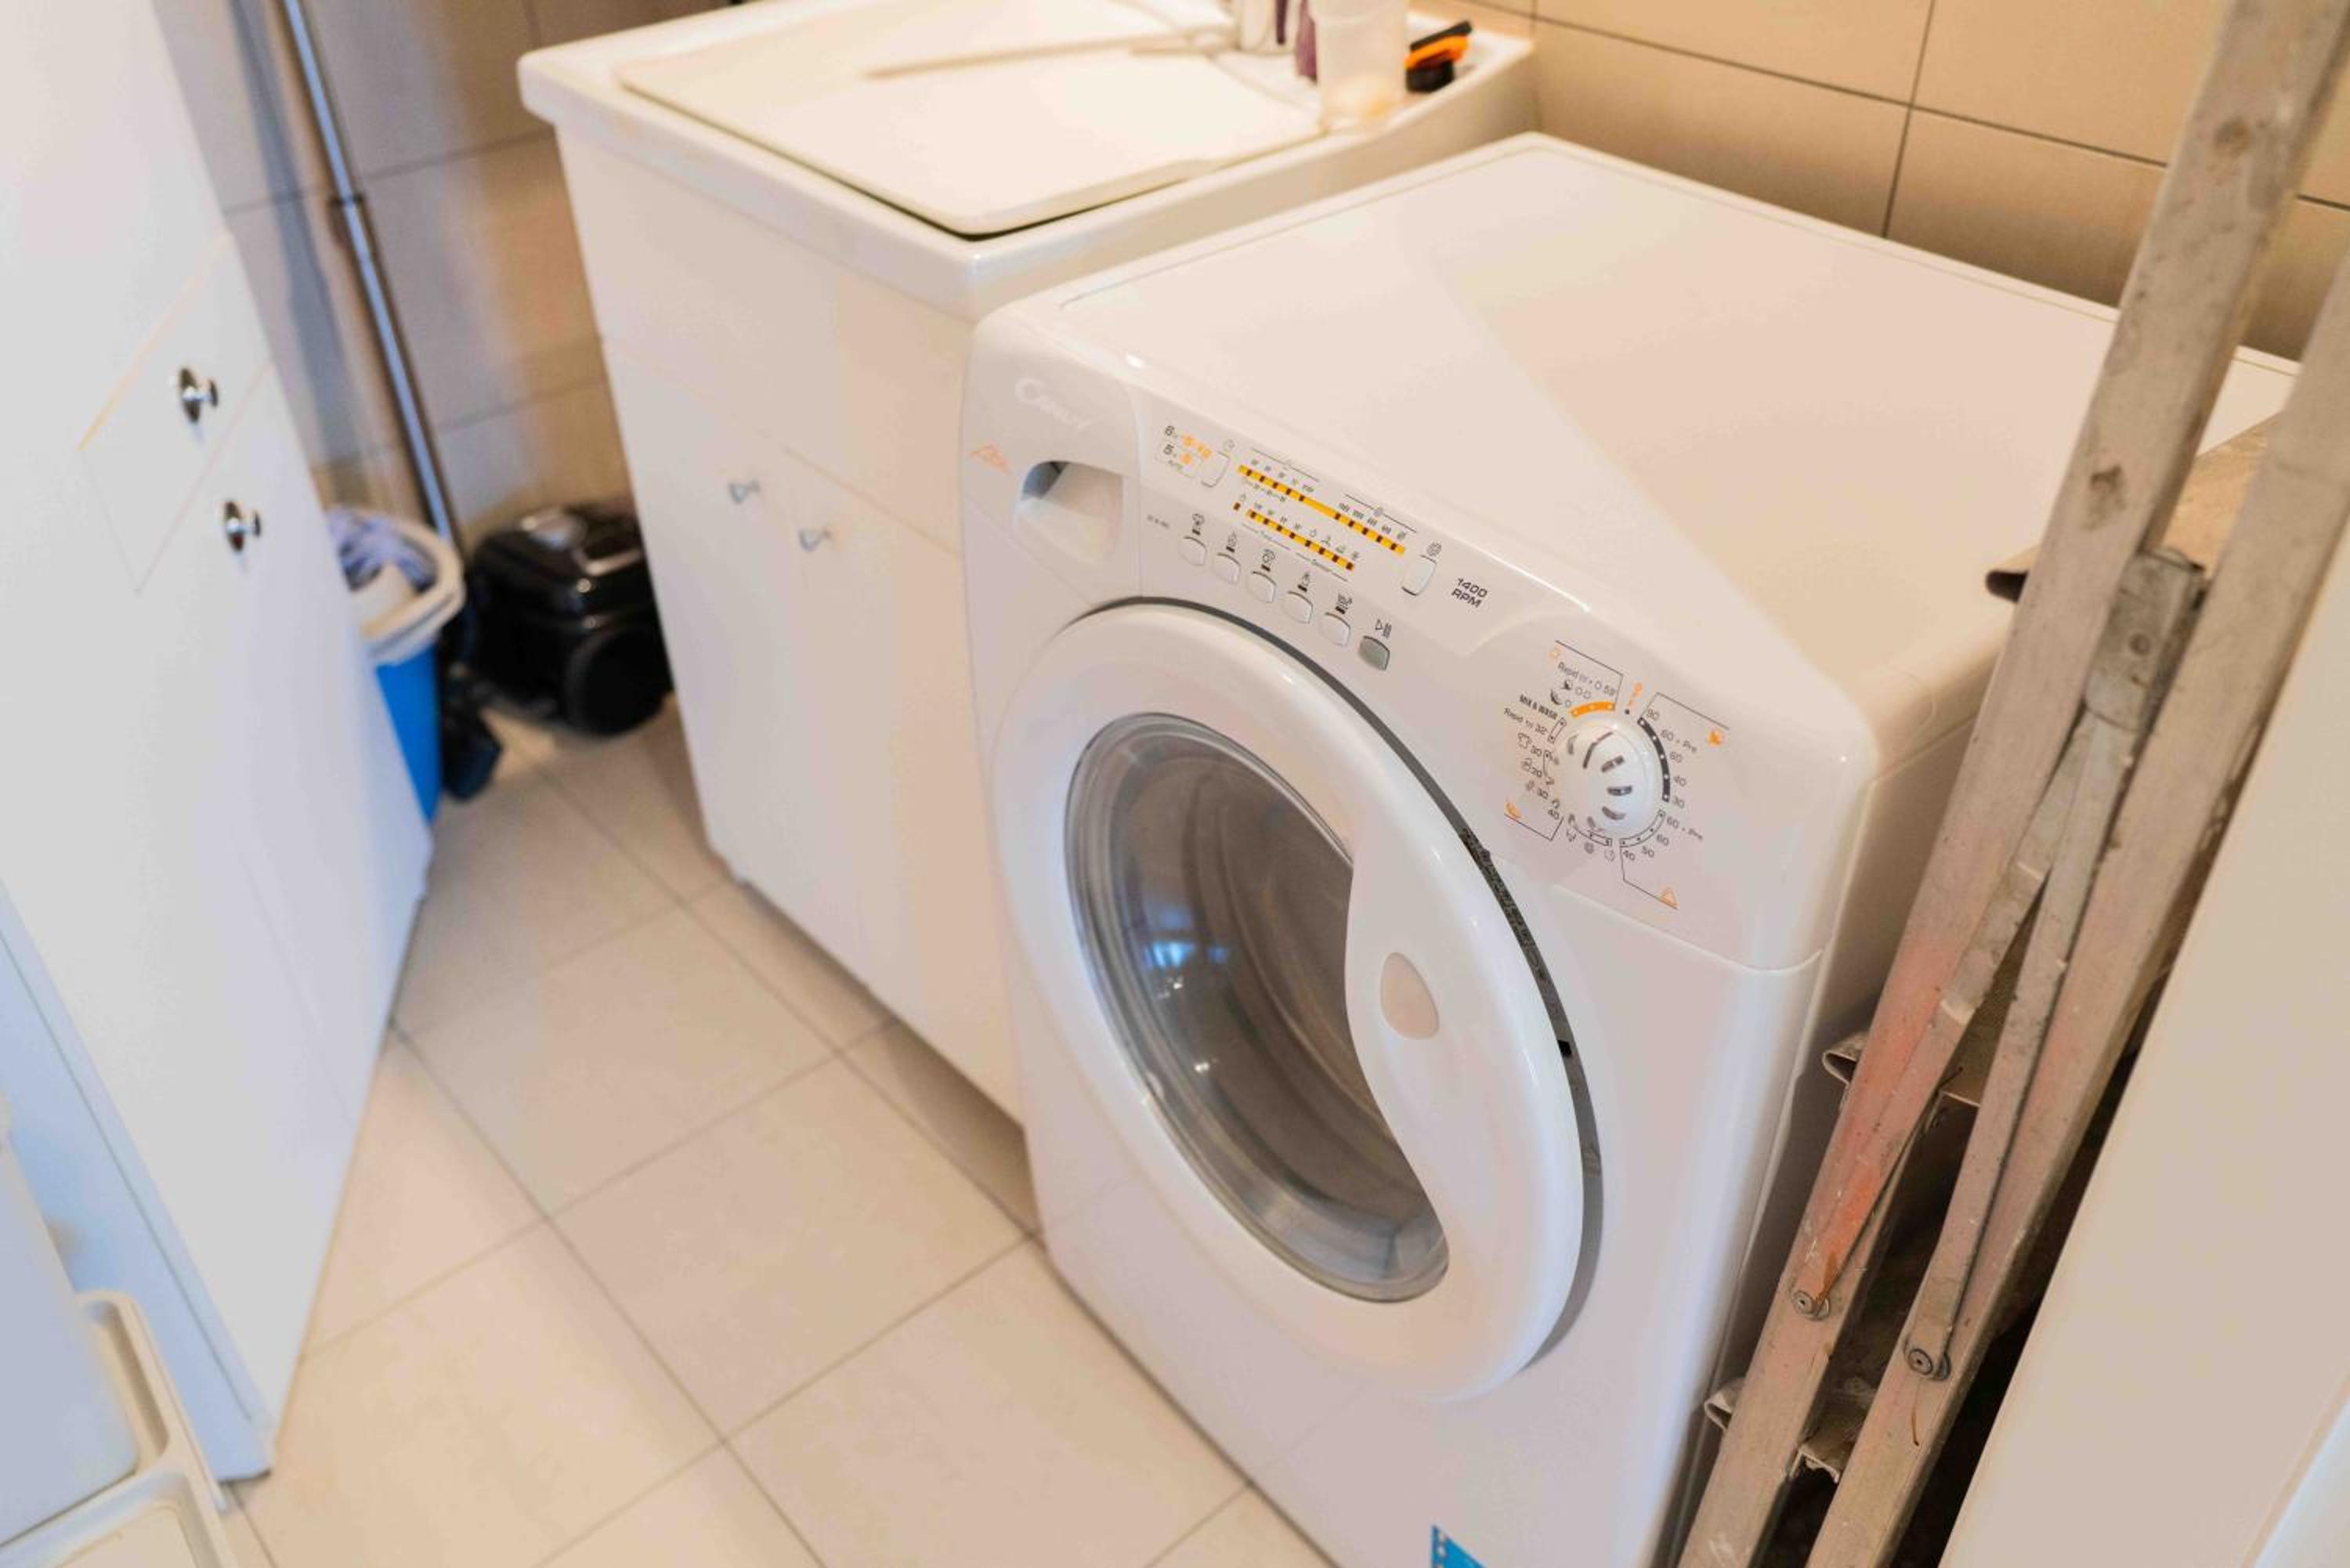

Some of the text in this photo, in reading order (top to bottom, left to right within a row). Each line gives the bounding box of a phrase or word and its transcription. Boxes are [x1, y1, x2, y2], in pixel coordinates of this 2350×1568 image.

[1458, 578, 1488, 598] 1400
[1452, 588, 1482, 608] RPM
[1647, 709, 1660, 721] 90
[1674, 775, 1687, 787] 40
[1548, 810, 1560, 820] 40
[1667, 816, 1679, 829] 60
[1624, 851, 1636, 862] 40
[1642, 846, 1654, 858] 50
